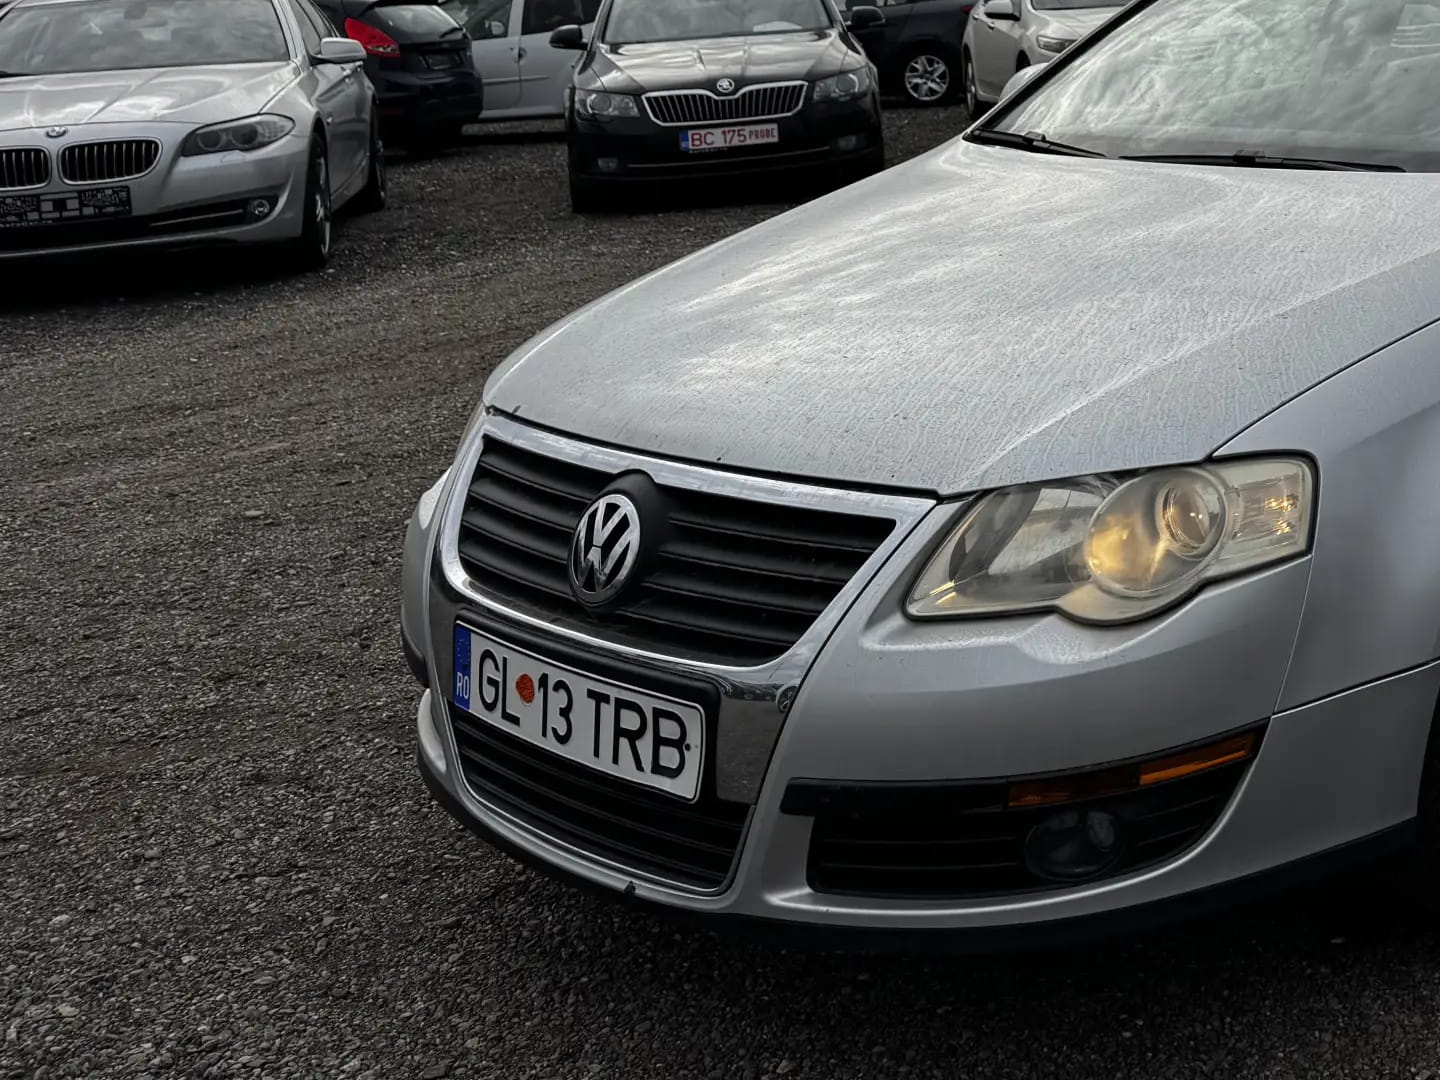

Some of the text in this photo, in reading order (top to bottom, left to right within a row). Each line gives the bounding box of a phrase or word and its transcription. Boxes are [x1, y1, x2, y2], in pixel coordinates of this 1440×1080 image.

[691, 131, 714, 147] BC
[722, 129, 747, 144] 175
[749, 128, 776, 140] PROBE
[456, 671, 470, 700] RO
[478, 648, 687, 779] GL 13 TRB
